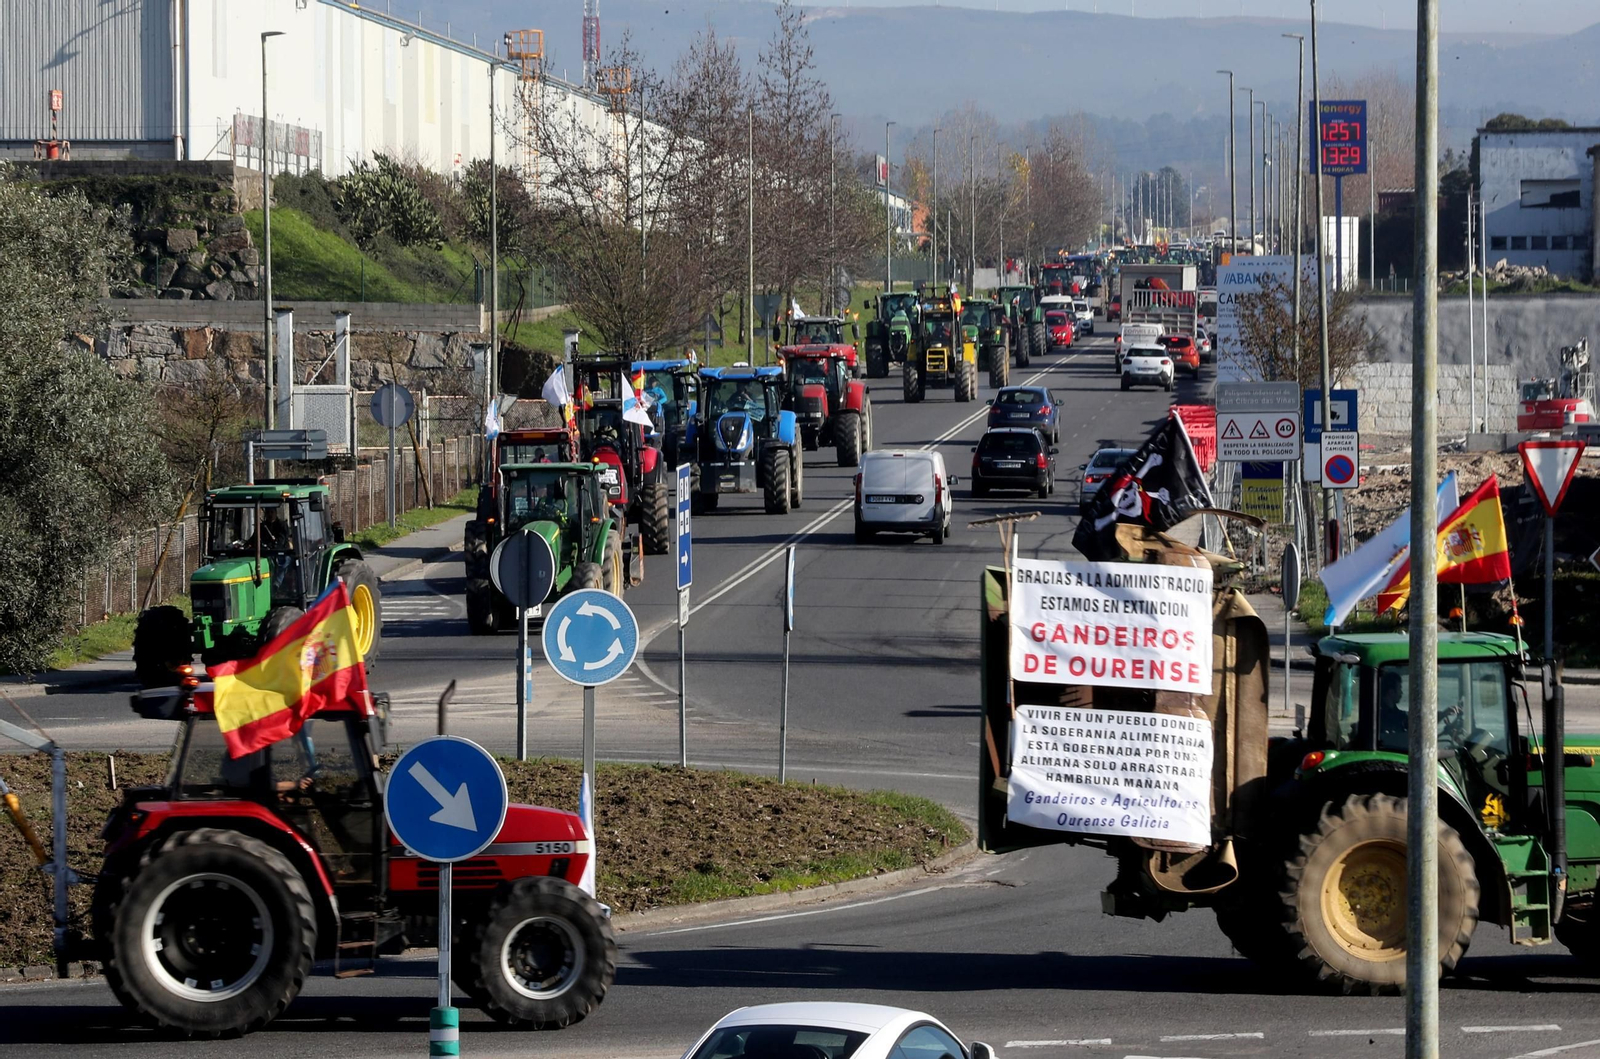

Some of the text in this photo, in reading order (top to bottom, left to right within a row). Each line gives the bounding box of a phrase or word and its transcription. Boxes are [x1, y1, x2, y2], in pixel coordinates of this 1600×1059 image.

[1017, 569, 1072, 586] GRACIAS
[1076, 572, 1083, 586] A
[1087, 573, 1101, 587] LA
[1041, 596, 1099, 612] ESTAMOS
[1104, 599, 1119, 614] EN
[1030, 622, 1195, 651] GANDEIROS
[1024, 653, 1200, 683] DE OURENSE
[1027, 709, 1202, 732] VIVIR EN UN PUEBLO DONDE
[1023, 725, 1037, 734] LA
[1042, 726, 1116, 740] SOBERANÍA
[1063, 743, 1141, 757] GOBERNADA
[1146, 749, 1170, 759] POR
[1174, 752, 1198, 762] UNA
[1021, 755, 1080, 768] ALIMAÑA
[1084, 760, 1117, 770] SOLO
[1046, 773, 1179, 791] HAMBRUNA MAÑANA
[1024, 790, 1198, 810] Gandeiros e Agricultores
[1057, 813, 1170, 829] Ourense Galicia
[535, 843, 571, 853] 5150
